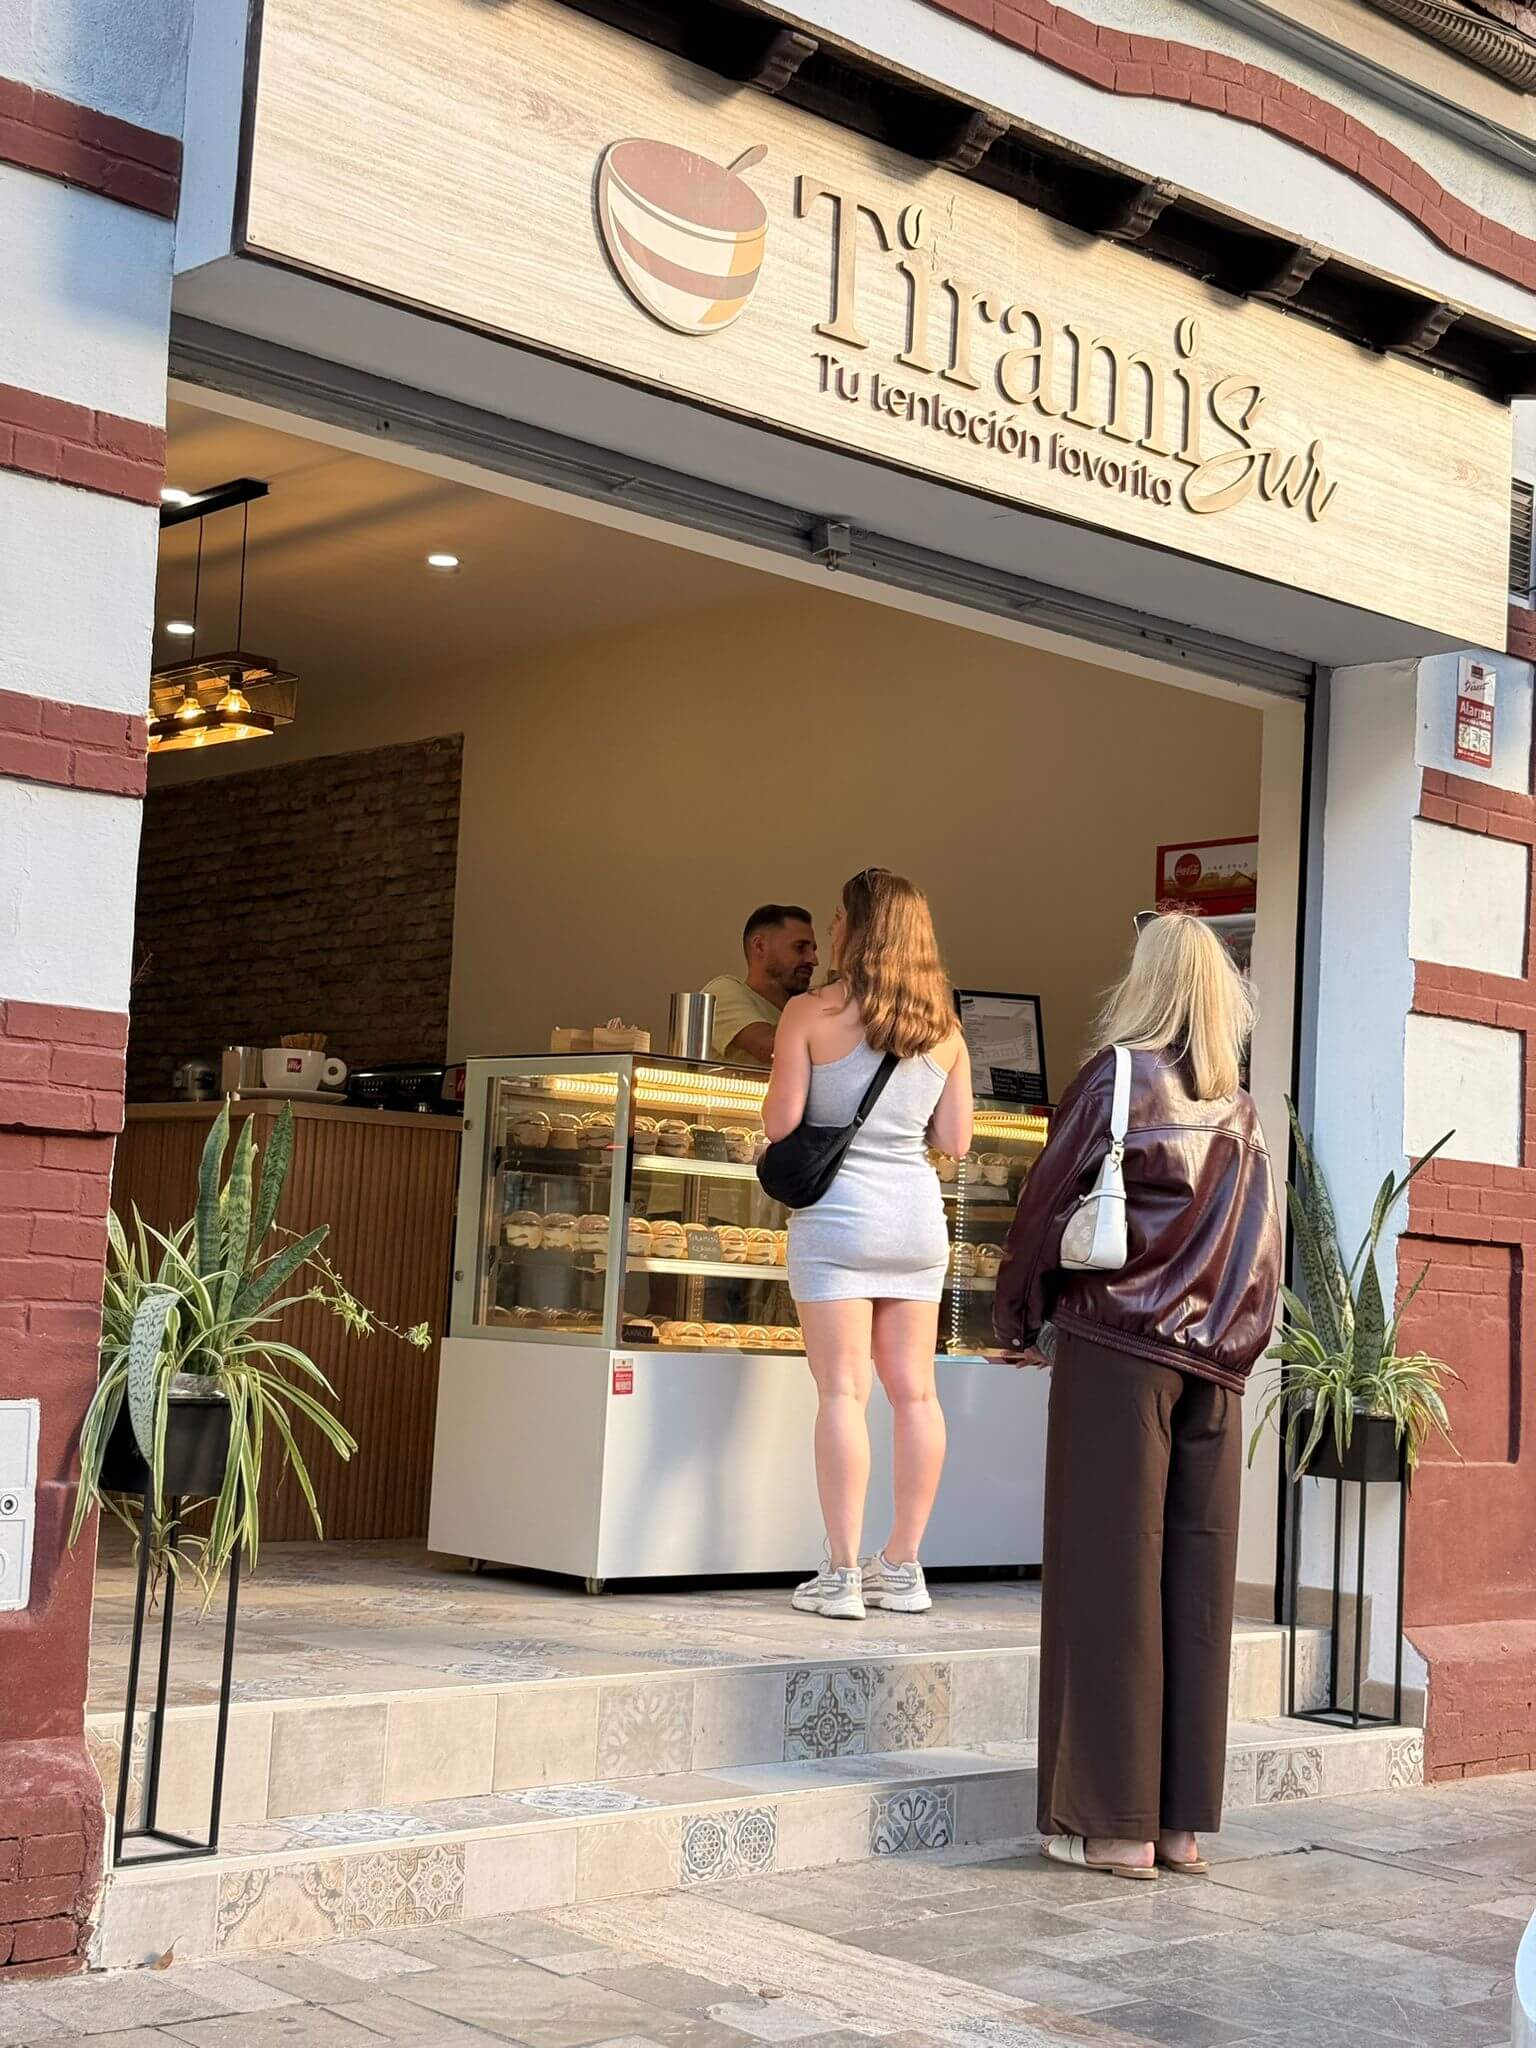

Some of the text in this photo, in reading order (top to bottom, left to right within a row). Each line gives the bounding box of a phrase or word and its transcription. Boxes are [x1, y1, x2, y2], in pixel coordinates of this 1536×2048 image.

[811, 352, 1173, 508] Tu tentación favorita
[1460, 701, 1492, 722] Alarma
